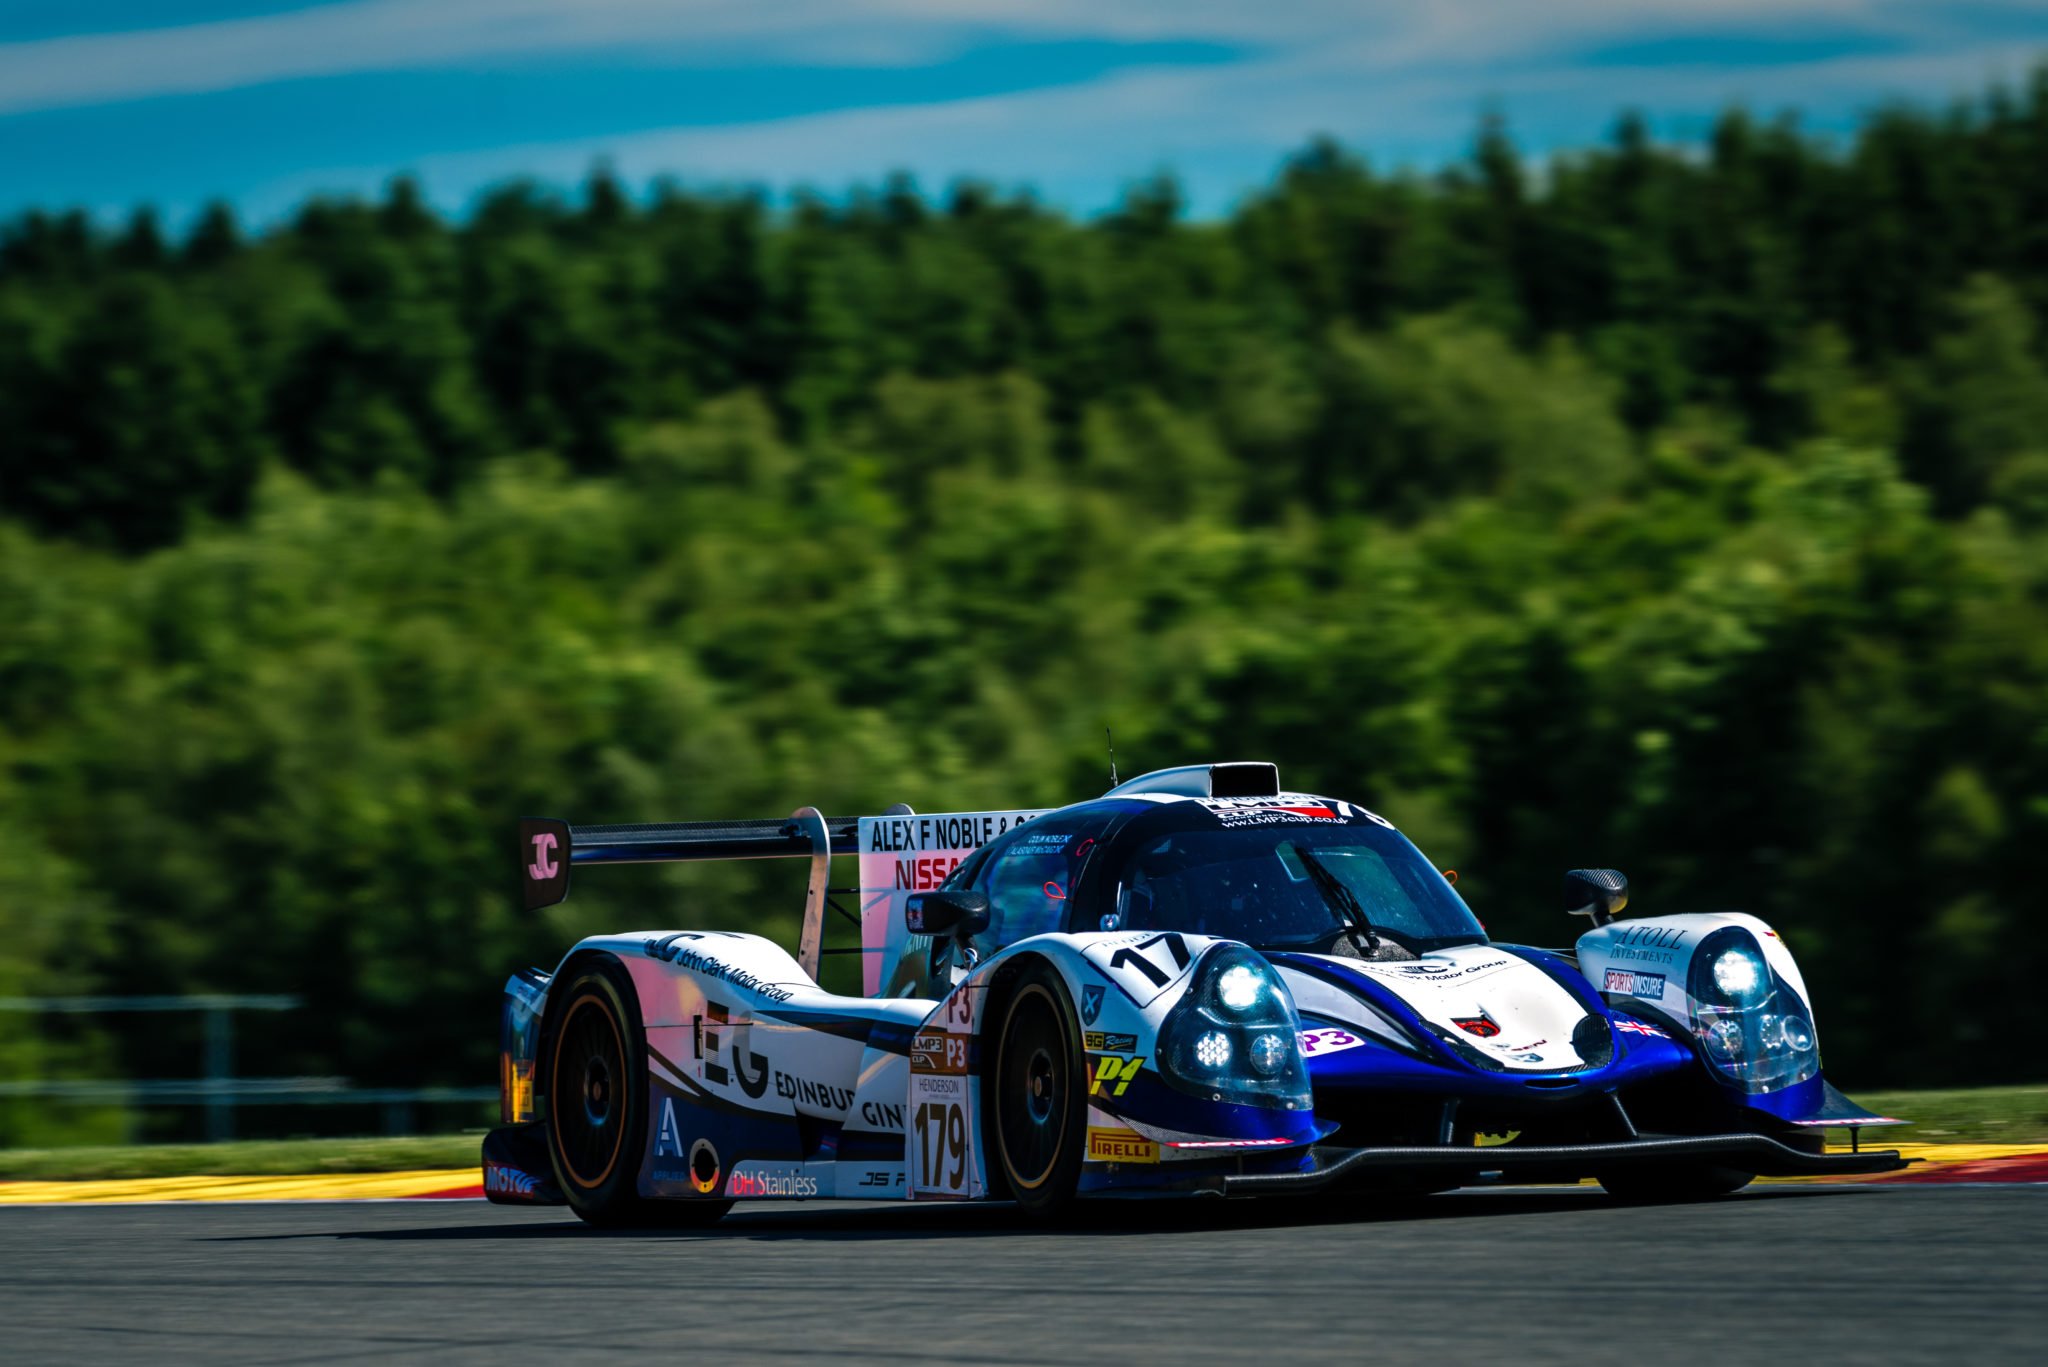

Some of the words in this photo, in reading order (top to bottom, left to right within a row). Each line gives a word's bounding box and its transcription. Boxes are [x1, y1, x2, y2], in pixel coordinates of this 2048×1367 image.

[871, 820, 915, 852] ALEX
[920, 819, 931, 850] F
[936, 817, 992, 850] NOBLE
[1616, 925, 1688, 950] ATOLL
[1465, 959, 1508, 974] Group
[1610, 948, 1674, 965] INVESTMENTS
[677, 949, 701, 972] John
[702, 957, 730, 981] Clark
[728, 968, 761, 992] Motor
[758, 982, 794, 1004] Group
[948, 985, 970, 1024] P3
[946, 1038, 966, 1068] P3
[1303, 1030, 1355, 1052] P3
[919, 1079, 959, 1093] HENDERSON
[1089, 1055, 1147, 1097] P1
[914, 1102, 966, 1190] 179
[1091, 1132, 1151, 1157] PIRELLI
[486, 1165, 538, 1193] MOTUL
[733, 1170, 755, 1194] DH
[757, 1170, 817, 1195] Stainless
